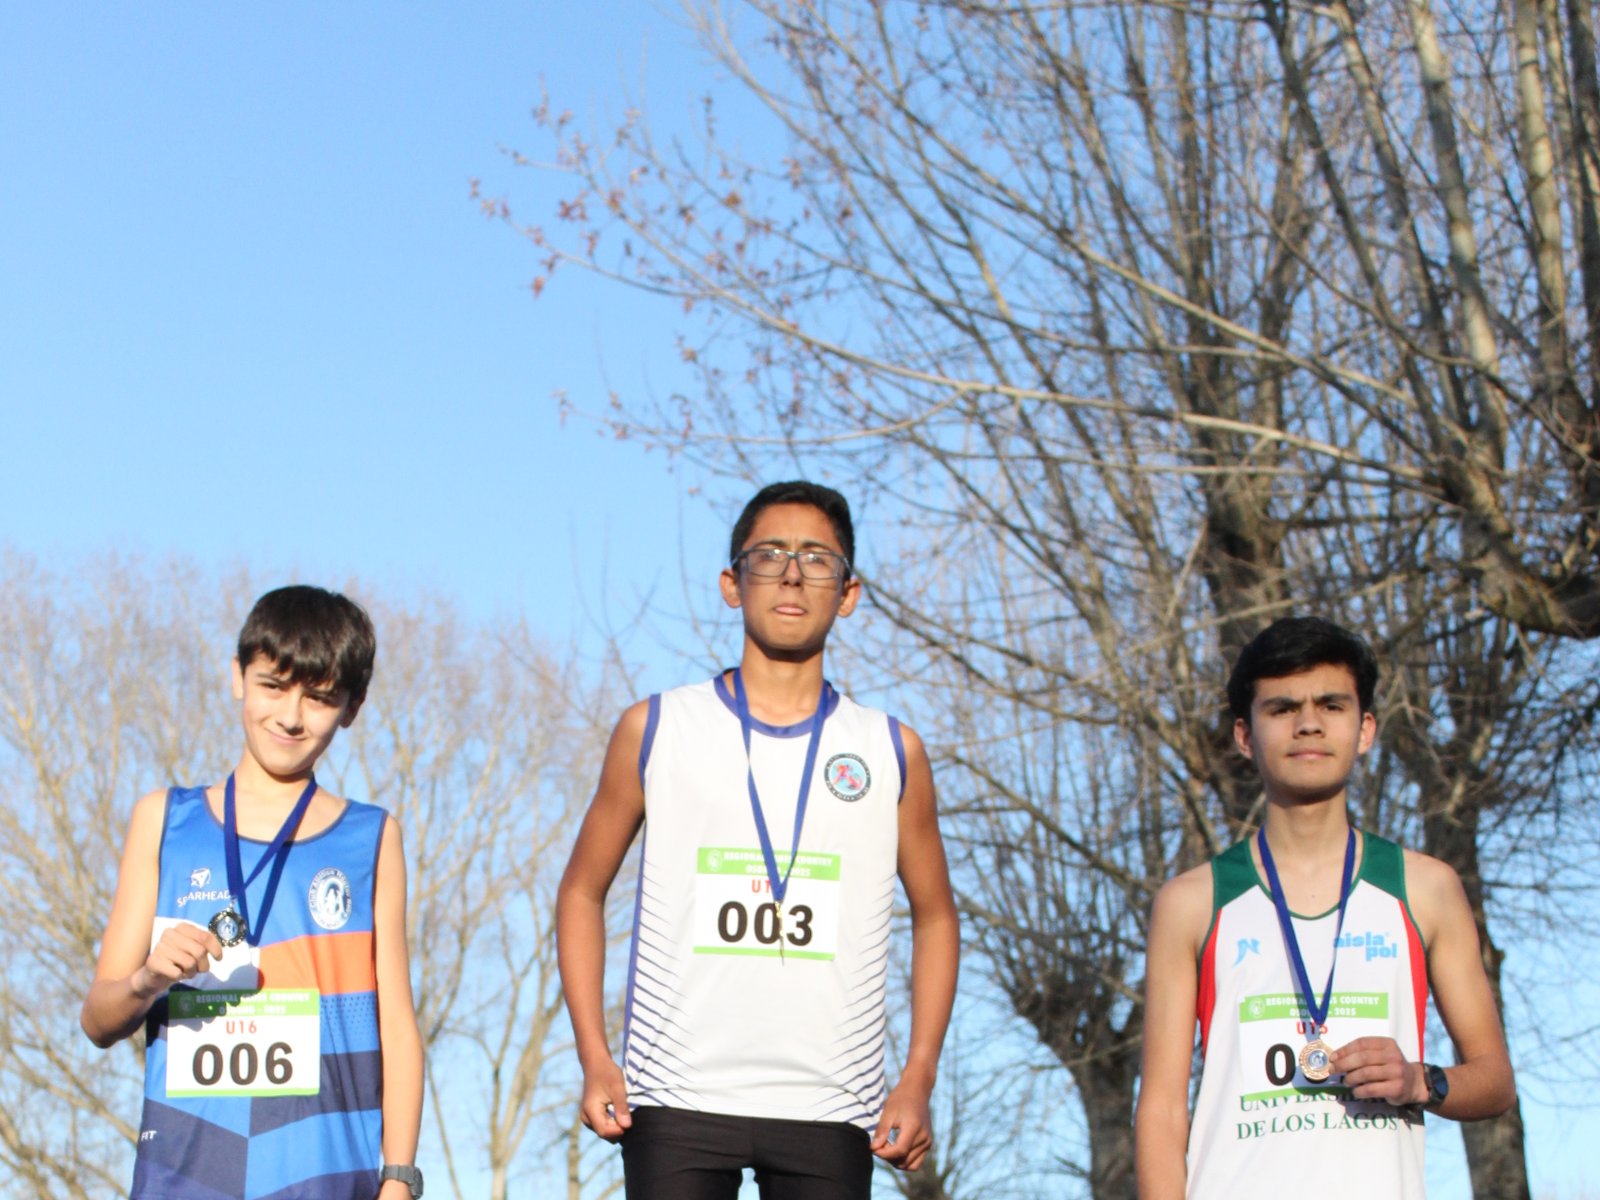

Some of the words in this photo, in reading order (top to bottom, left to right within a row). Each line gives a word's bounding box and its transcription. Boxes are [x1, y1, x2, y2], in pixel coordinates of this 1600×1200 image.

[724, 852, 765, 861] REGIONA
[718, 901, 813, 947] 003
[1366, 943, 1398, 961] pol
[196, 994, 238, 1003] REGIONAL
[1340, 996, 1379, 1005] COUNTRY
[226, 1020, 257, 1035] U16
[193, 1042, 293, 1086] 006
[1237, 1120, 1266, 1140] DE
[1271, 1113, 1316, 1133] LOS
[1323, 1112, 1399, 1131] LAGOS
